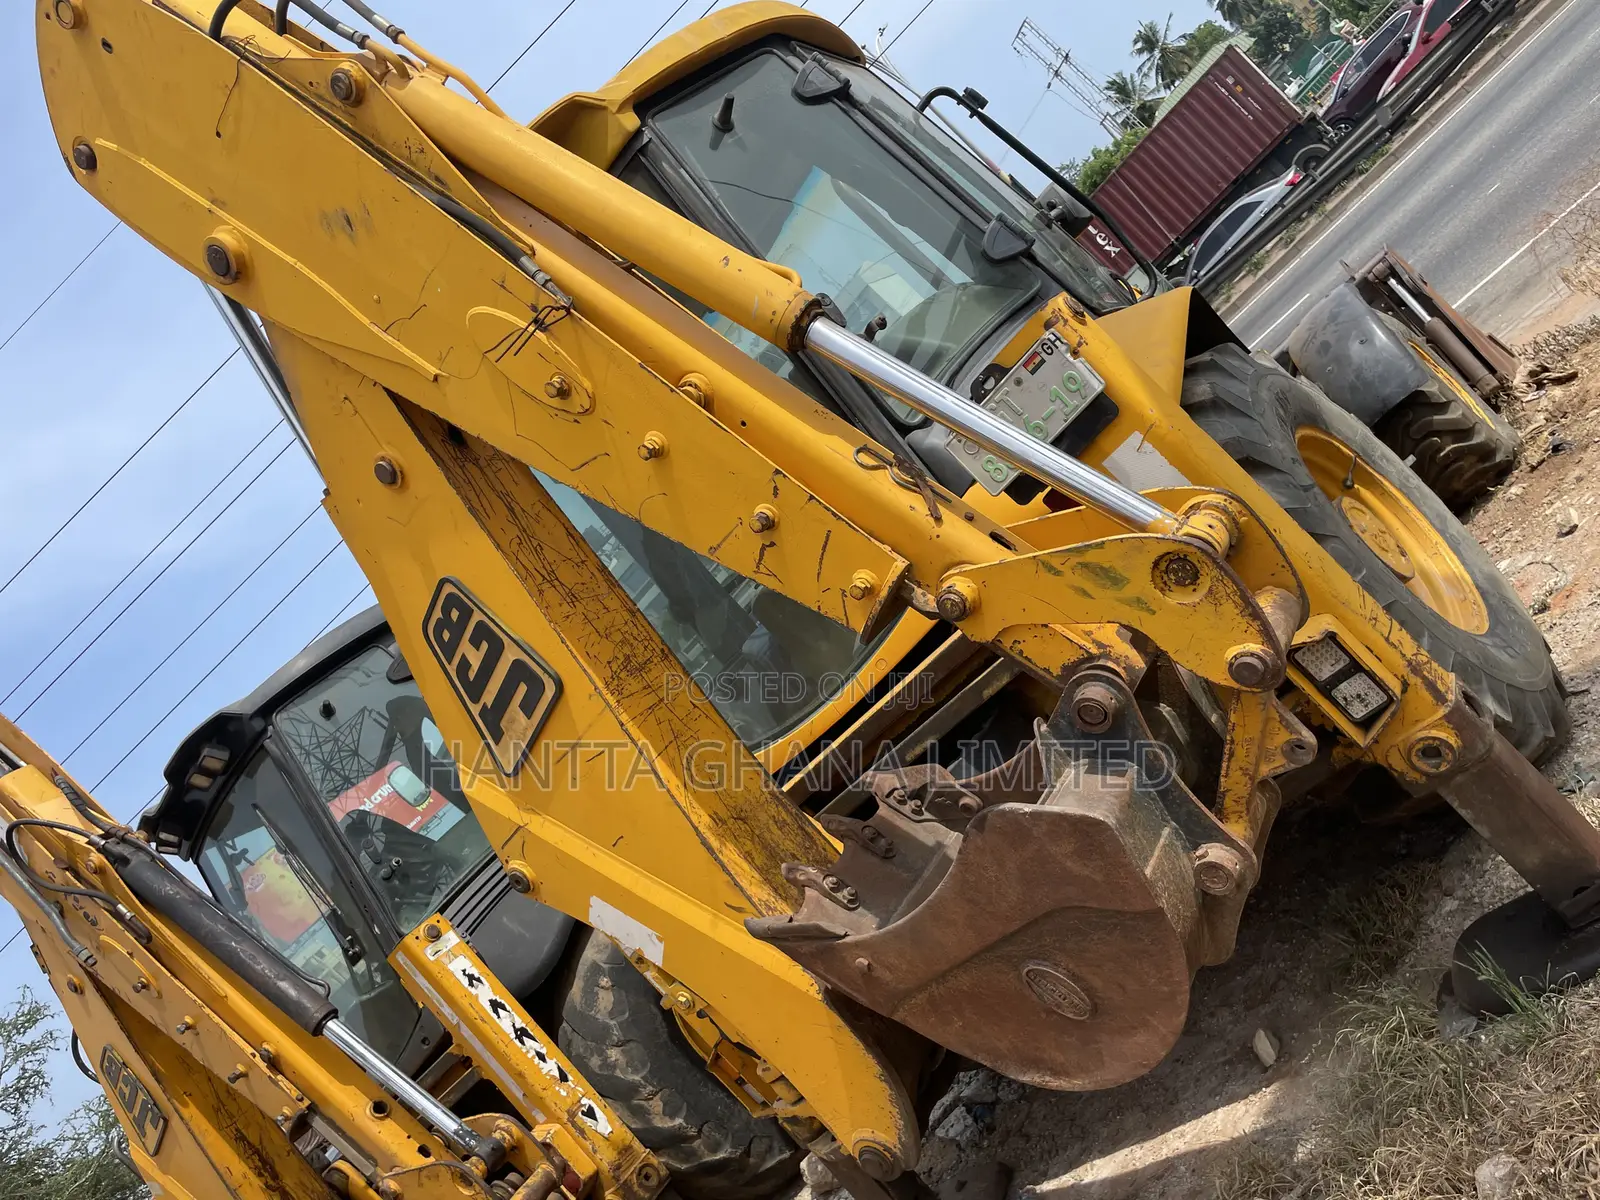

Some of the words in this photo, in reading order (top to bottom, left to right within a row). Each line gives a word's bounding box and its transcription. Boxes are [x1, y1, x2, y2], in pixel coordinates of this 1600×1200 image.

[1040, 332, 1065, 356] GH
[981, 369, 1088, 483] 86-19
[432, 591, 546, 746] JCB
[104, 1053, 161, 1138] JCB
